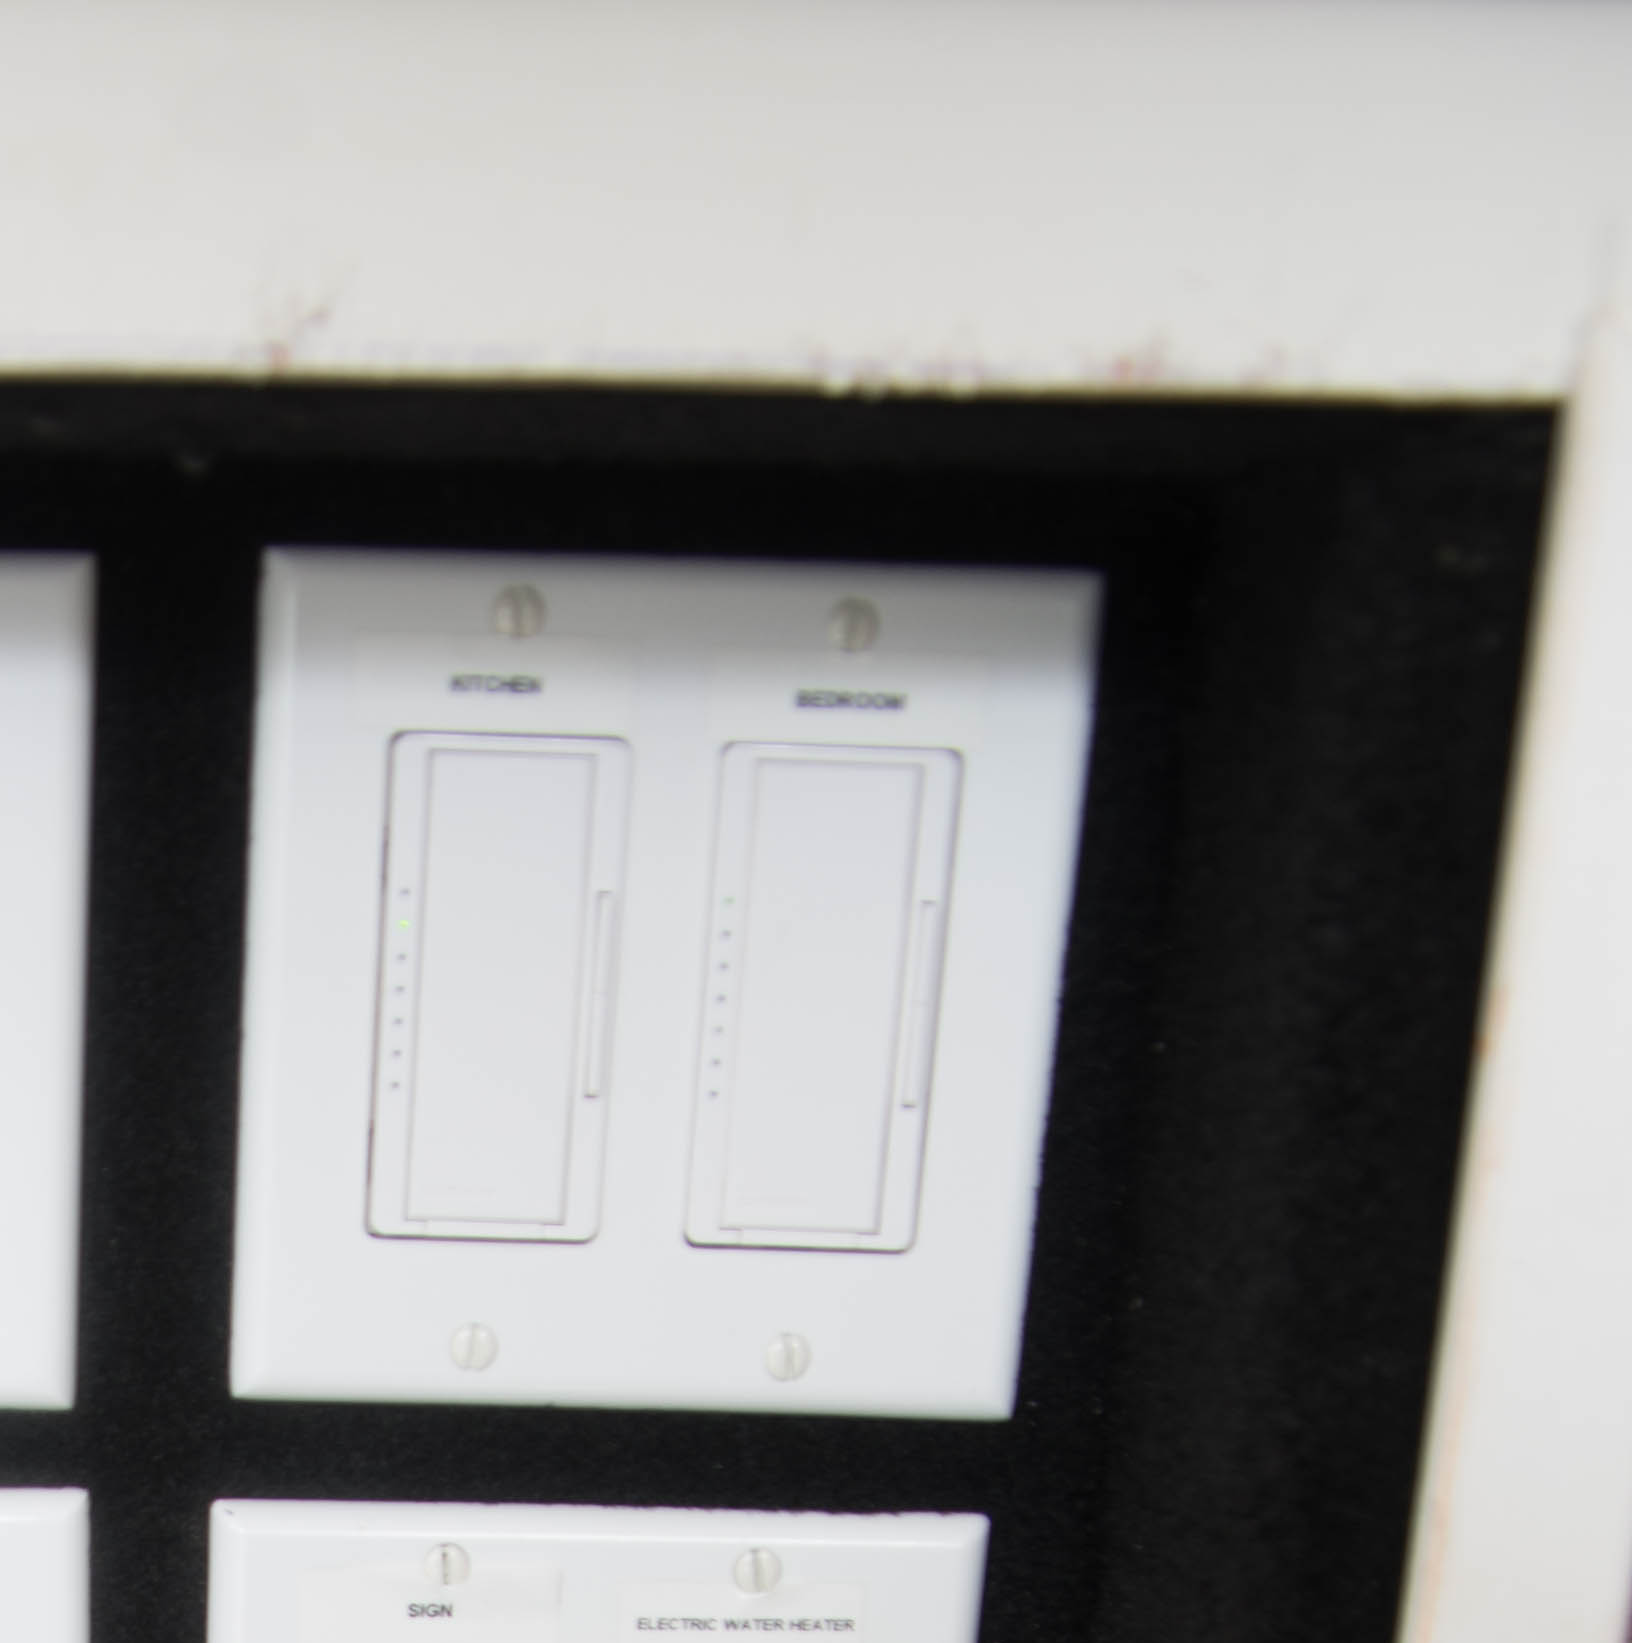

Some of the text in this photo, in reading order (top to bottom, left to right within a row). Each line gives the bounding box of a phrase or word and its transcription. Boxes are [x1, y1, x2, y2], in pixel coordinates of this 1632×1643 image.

[450, 674, 543, 695] KITCHEN
[795, 688, 906, 709] BEDROOM
[408, 1603, 453, 1618] SIGN
[637, 1617, 856, 1632] ELECTRIC WATER HEATER
